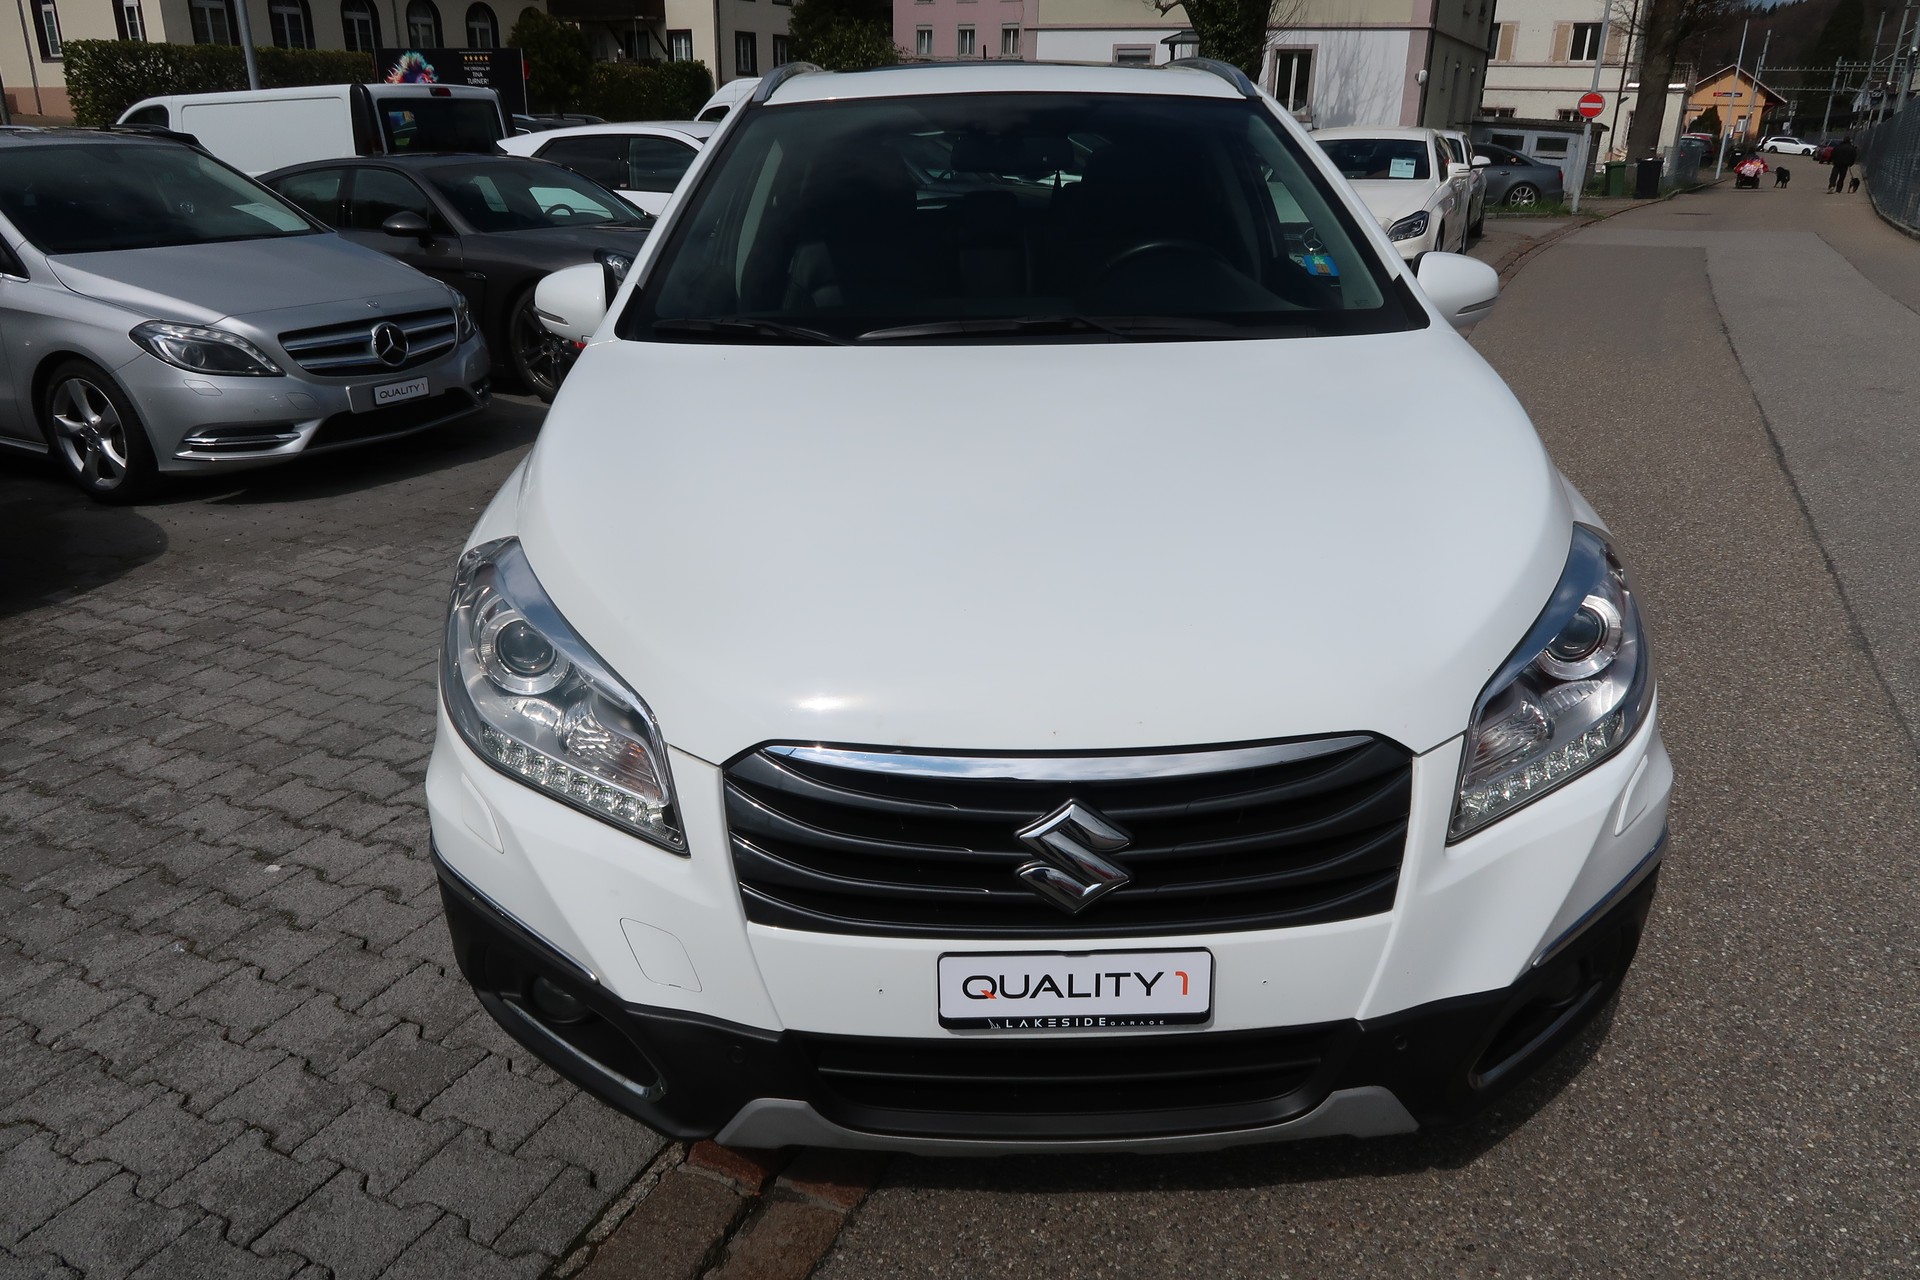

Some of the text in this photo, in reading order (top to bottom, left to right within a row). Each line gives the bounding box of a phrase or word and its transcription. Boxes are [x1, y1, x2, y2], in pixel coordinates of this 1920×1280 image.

[380, 384, 420, 398] QUALITY
[962, 971, 1189, 1000] QUALITY 1
[1005, 1017, 1106, 1029] LAKESIDE
